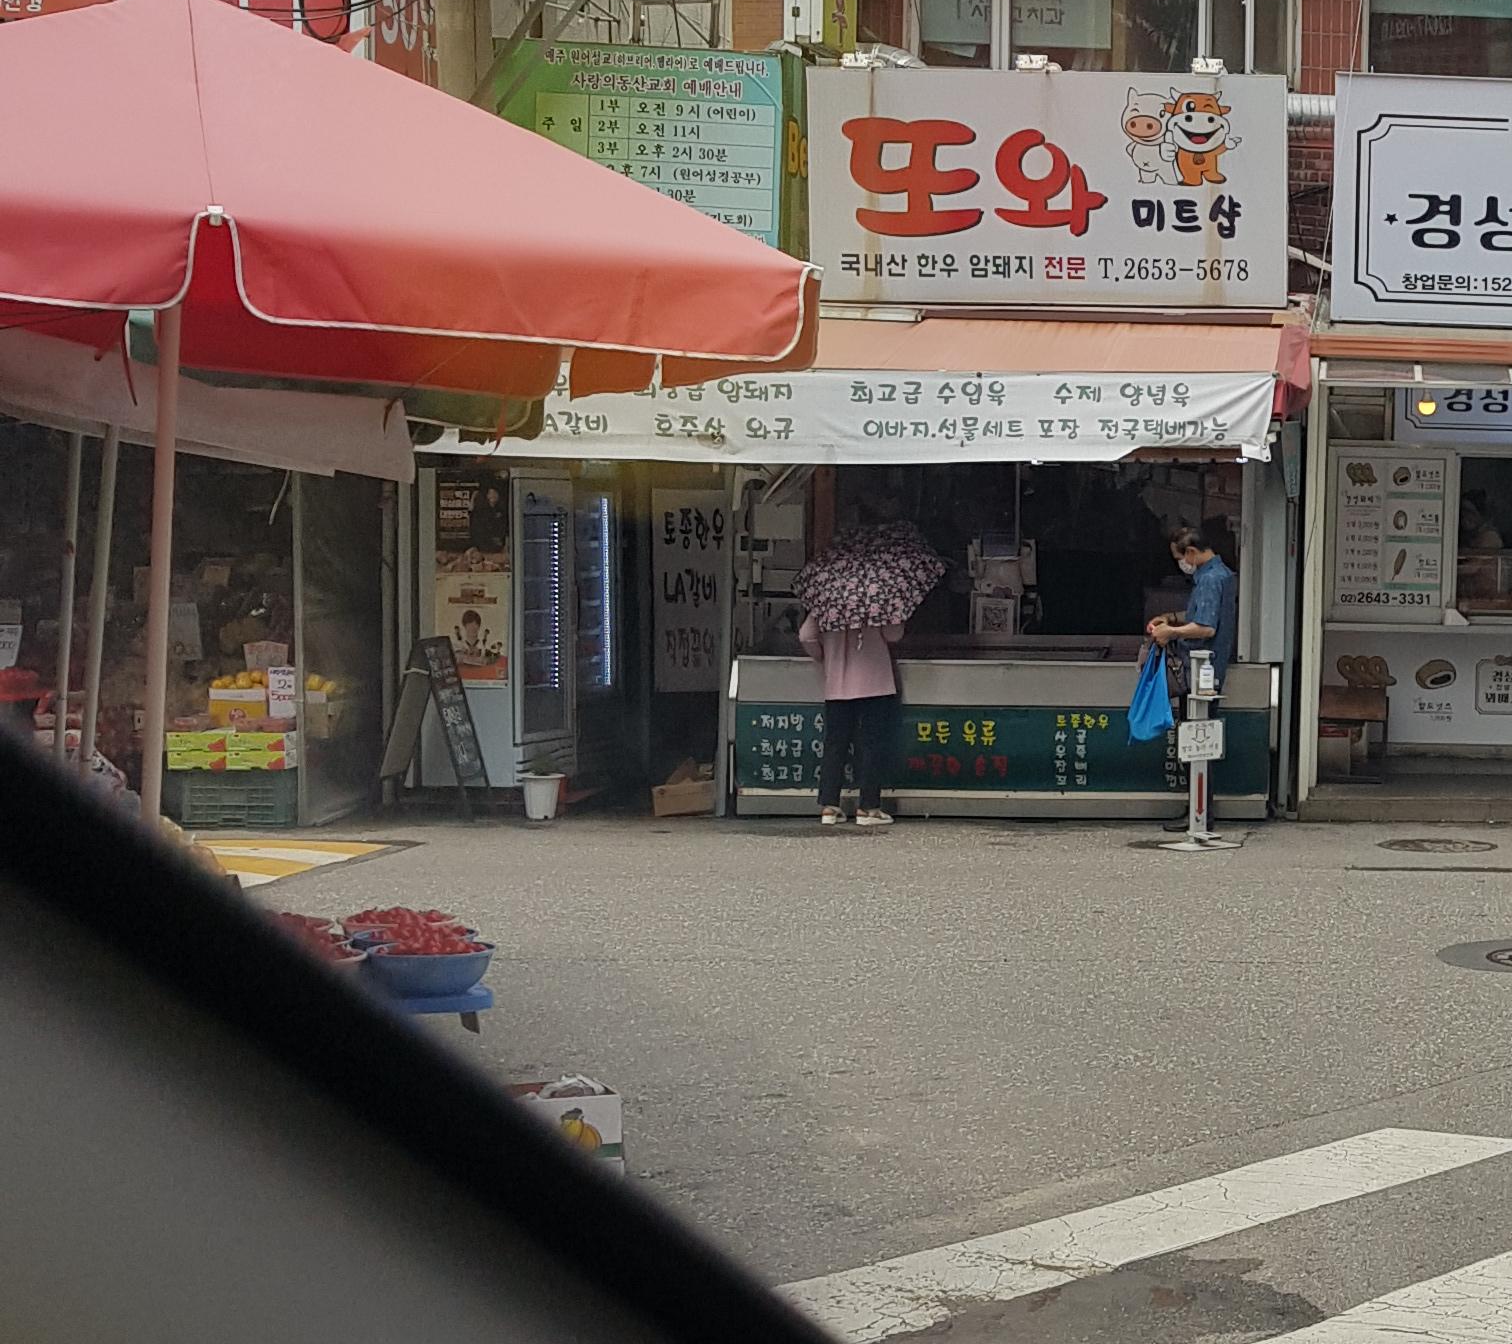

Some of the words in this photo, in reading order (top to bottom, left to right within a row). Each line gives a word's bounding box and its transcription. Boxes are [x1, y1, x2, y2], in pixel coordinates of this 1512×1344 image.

[571, 72, 677, 96] 사랑의동산교회
[683, 78, 743, 99] 예배안내
[637, 100, 666, 117] 오전
[597, 119, 620, 134] 2부
[636, 123, 666, 138] 오전
[672, 124, 701, 140] 11시
[597, 140, 620, 156] 3부
[635, 145, 666, 160] 오후
[672, 146, 693, 161] 2시
[698, 148, 728, 163] 30분
[640, 165, 661, 180] 7시
[842, 117, 1108, 237] 또와
[1132, 195, 1241, 238] 미트샵
[841, 254, 907, 278] 국내산
[917, 254, 960, 278] 한우
[969, 255, 1033, 280] 암돼지
[1044, 256, 1085, 280] 전문
[1098, 257, 1249, 282] T.2653-5678
[717, 381, 793, 401] 암돼지
[850, 381, 923, 405] 최고급
[937, 381, 1007, 406] 수입육
[1054, 382, 1100, 404] 수제
[1119, 382, 1191, 407] 양념육
[655, 414, 727, 438] 호주산
[745, 417, 794, 440] 와규
[1039, 419, 1080, 438] 포장
[1100, 416, 1229, 443] 전국택배가능
[664, 508, 724, 549] 토종한우
[664, 569, 717, 608] LA갈비
[1341, 592, 1431, 605] 02)2643-3331
[761, 713, 804, 730] 저지방
[918, 721, 950, 743] 모든
[964, 720, 996, 746] 육류
[761, 739, 803, 756] 최상급
[761, 764, 803, 782] 최고급
